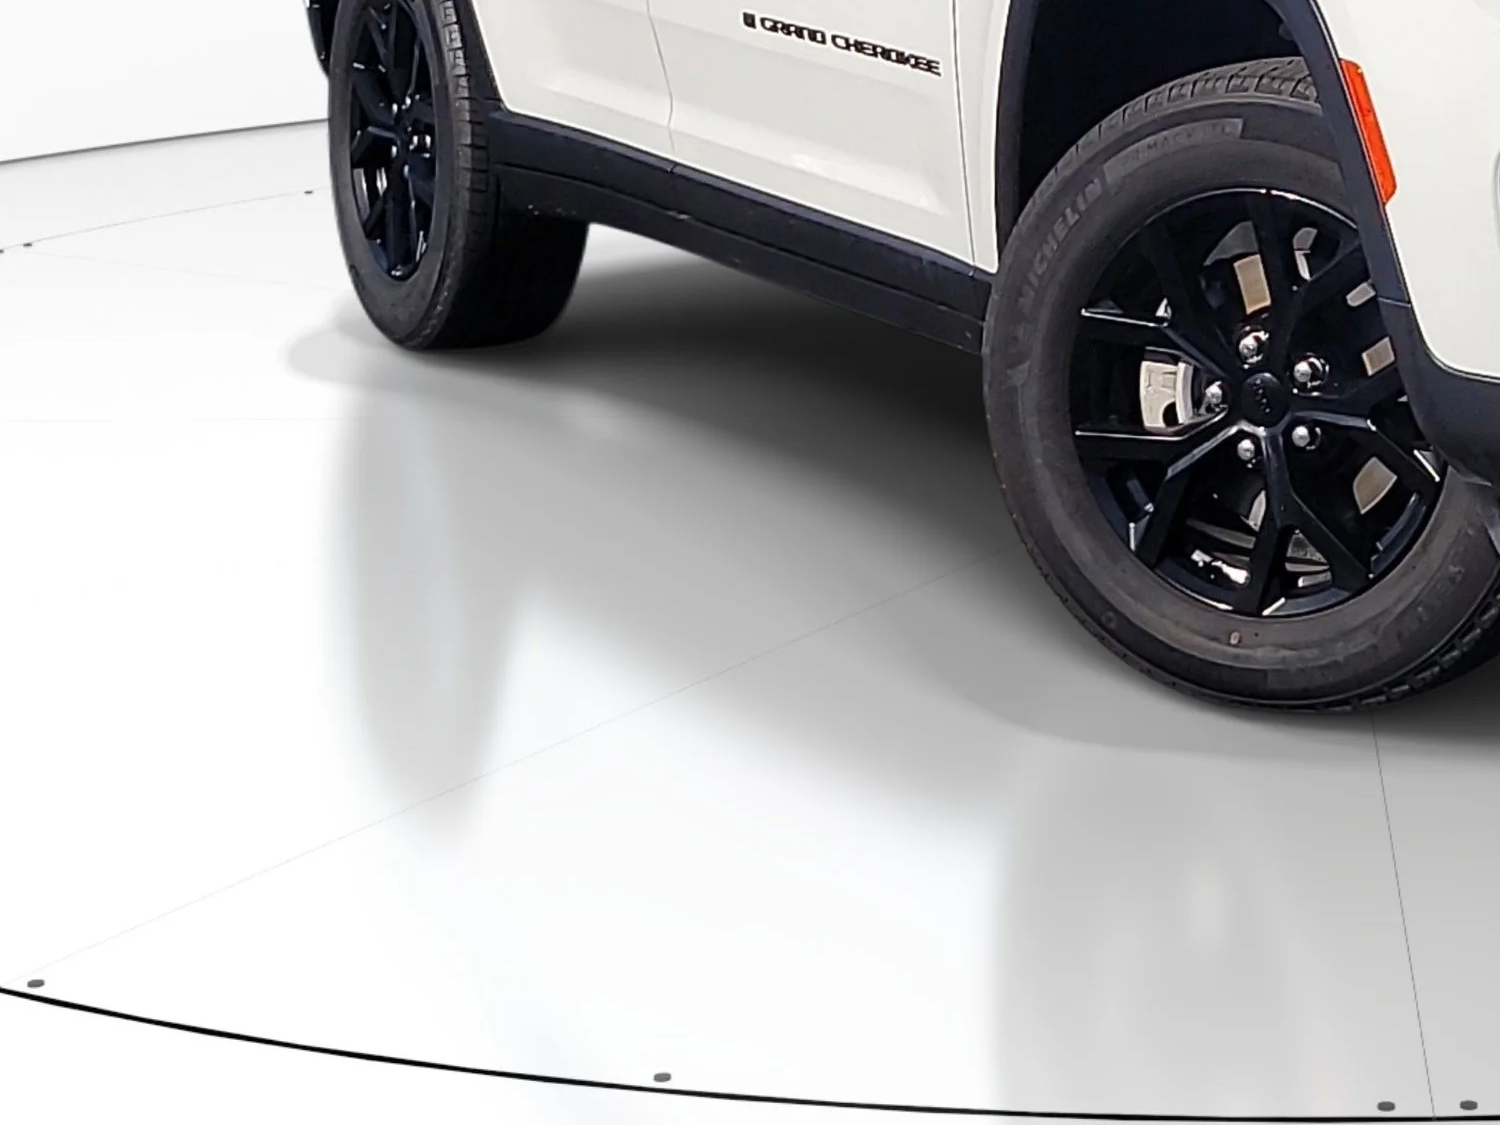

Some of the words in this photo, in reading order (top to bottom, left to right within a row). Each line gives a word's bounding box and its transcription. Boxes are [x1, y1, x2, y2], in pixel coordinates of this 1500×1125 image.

[759, 16, 827, 46] GRAND
[830, 33, 943, 77] CHEROKEE
[1017, 176, 1103, 310] MICHELIN
